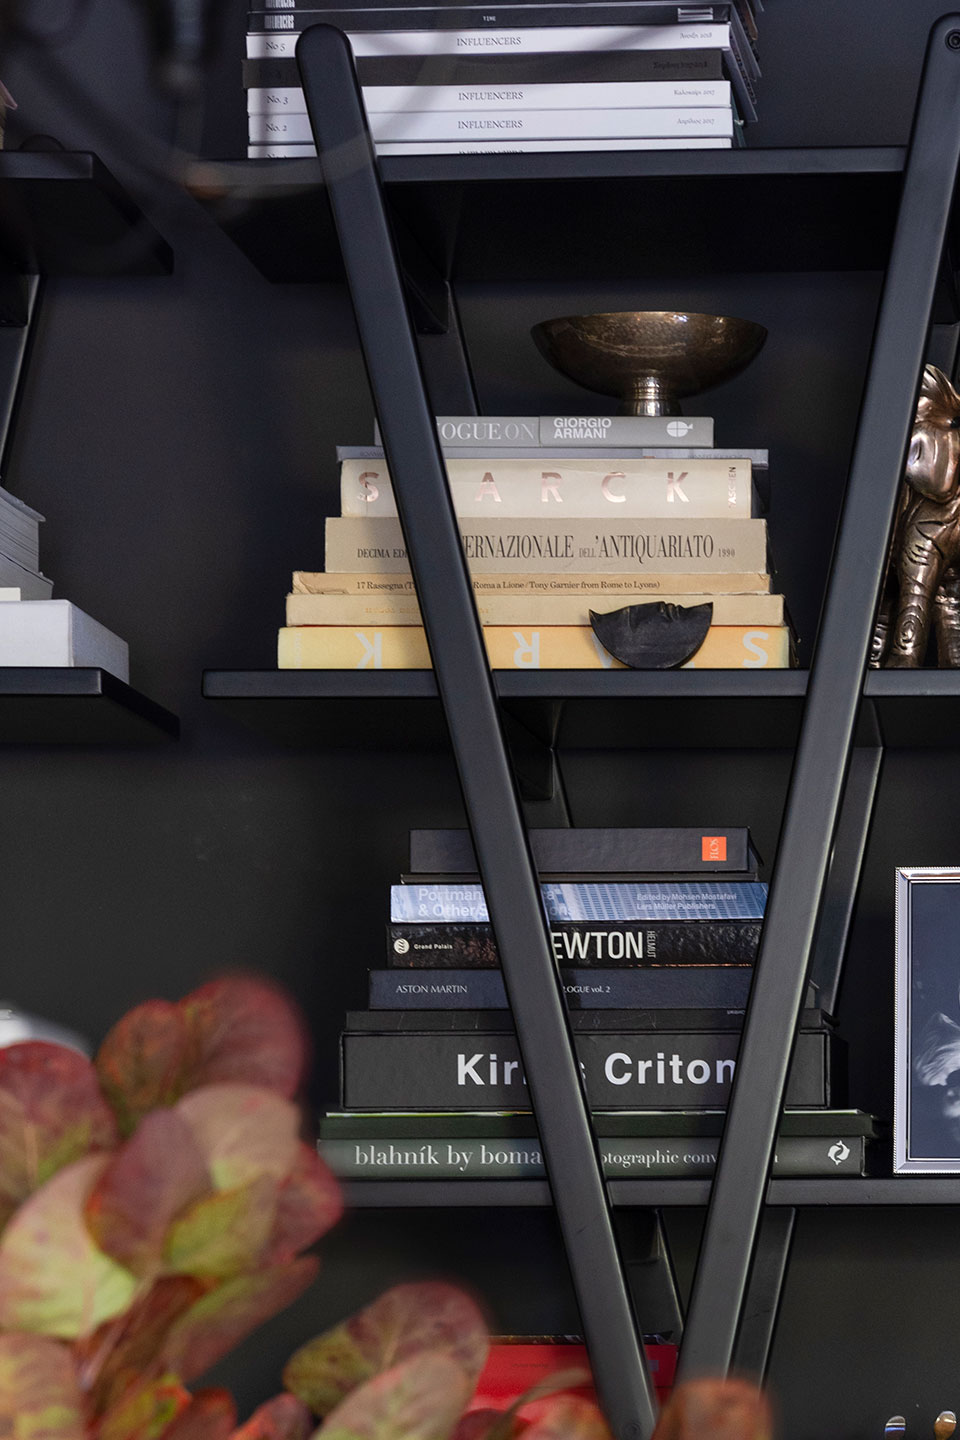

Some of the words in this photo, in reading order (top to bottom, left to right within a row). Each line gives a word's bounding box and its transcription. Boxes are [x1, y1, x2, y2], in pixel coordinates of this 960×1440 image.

[456, 36, 522, 47] INFLUENCERS
[458, 90, 524, 101] INFLUENCERS
[457, 119, 523, 130] INFLUENCERS
[553, 417, 613, 429] GIORGIO
[437, 422, 501, 440] OGUE
[505, 423, 535, 440] ON
[553, 428, 607, 440] ARMANI
[462, 535, 574, 559] ERNAZIONALE
[357, 548, 391, 559] DECIMA
[356, 581, 366, 589] 17
[366, 581, 404, 591] Rassegna
[473, 580, 496, 590] Roma
[502, 580, 525, 589] Lione
[529, 580, 549, 591] Tony
[550, 580, 580, 589] Garnier
[581, 580, 600, 589] from
[600, 580, 624, 589] Rome
[624, 581, 633, 589] to
[710, 839, 719, 859] FLOS
[417, 888, 483, 901] Portman
[637, 892, 661, 901] Edited
[661, 893, 672, 902] by
[672, 892, 701, 901] Mohsen
[417, 904, 430, 917] &
[432, 903, 474, 917] Other
[636, 902, 653, 911] Lars
[677, 902, 716, 911] Publishers
[551, 932, 643, 960] EWTON
[647, 930, 657, 958] HELMUT
[395, 984, 430, 994] ASTON
[430, 984, 468, 994] MARTIN
[354, 1144, 441, 1166] blahník
[446, 1144, 474, 1172] by
[479, 1145, 542, 1166] boma
